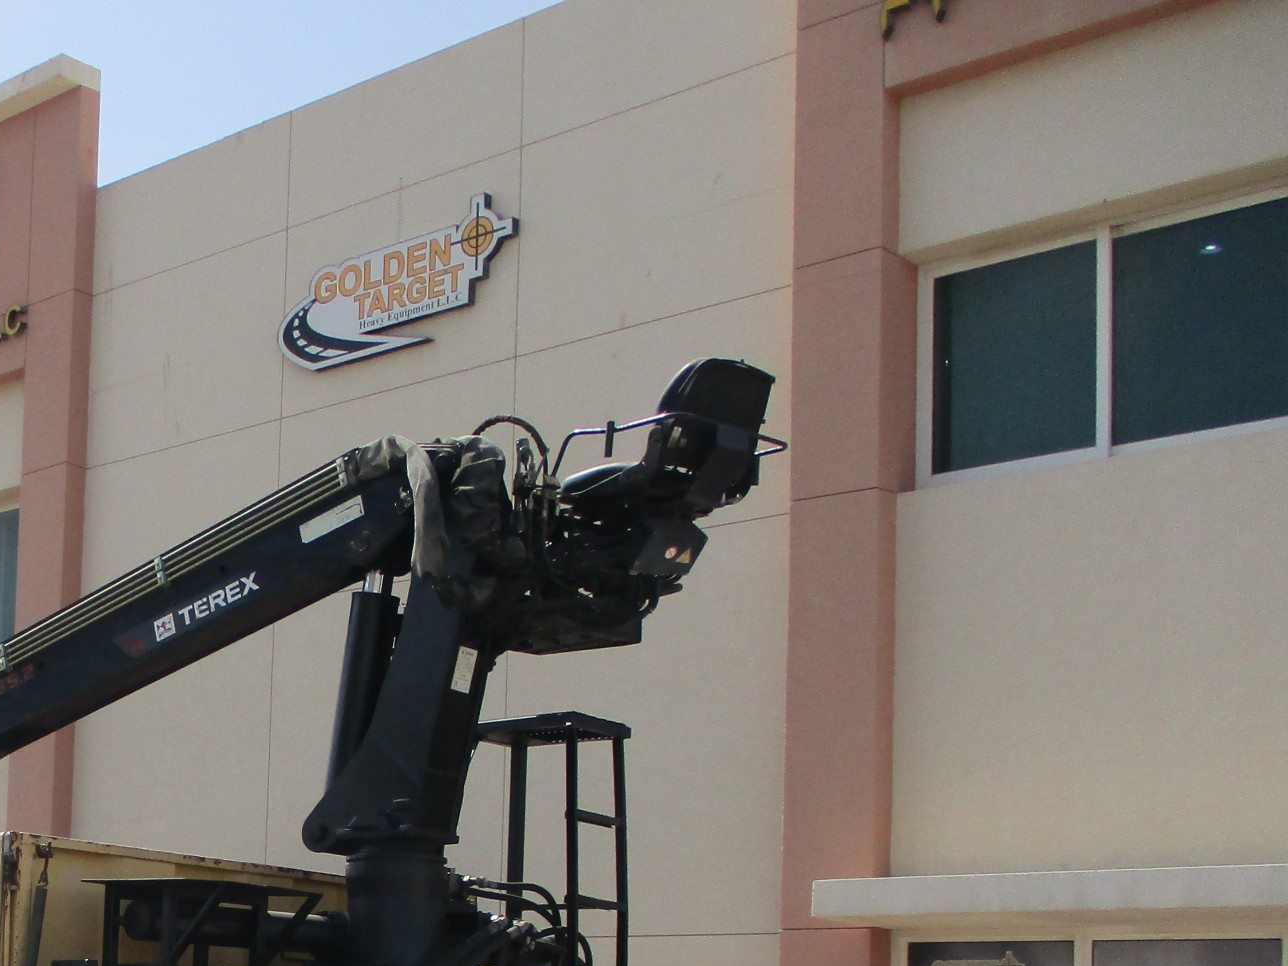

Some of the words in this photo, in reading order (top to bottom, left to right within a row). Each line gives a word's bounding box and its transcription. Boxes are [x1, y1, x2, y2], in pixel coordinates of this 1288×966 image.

[314, 233, 452, 305] GOLDEN
[353, 263, 464, 320] TARGET
[359, 316, 384, 330] Heavy
[387, 301, 435, 321] Equipment
[178, 571, 260, 626] TEREX
